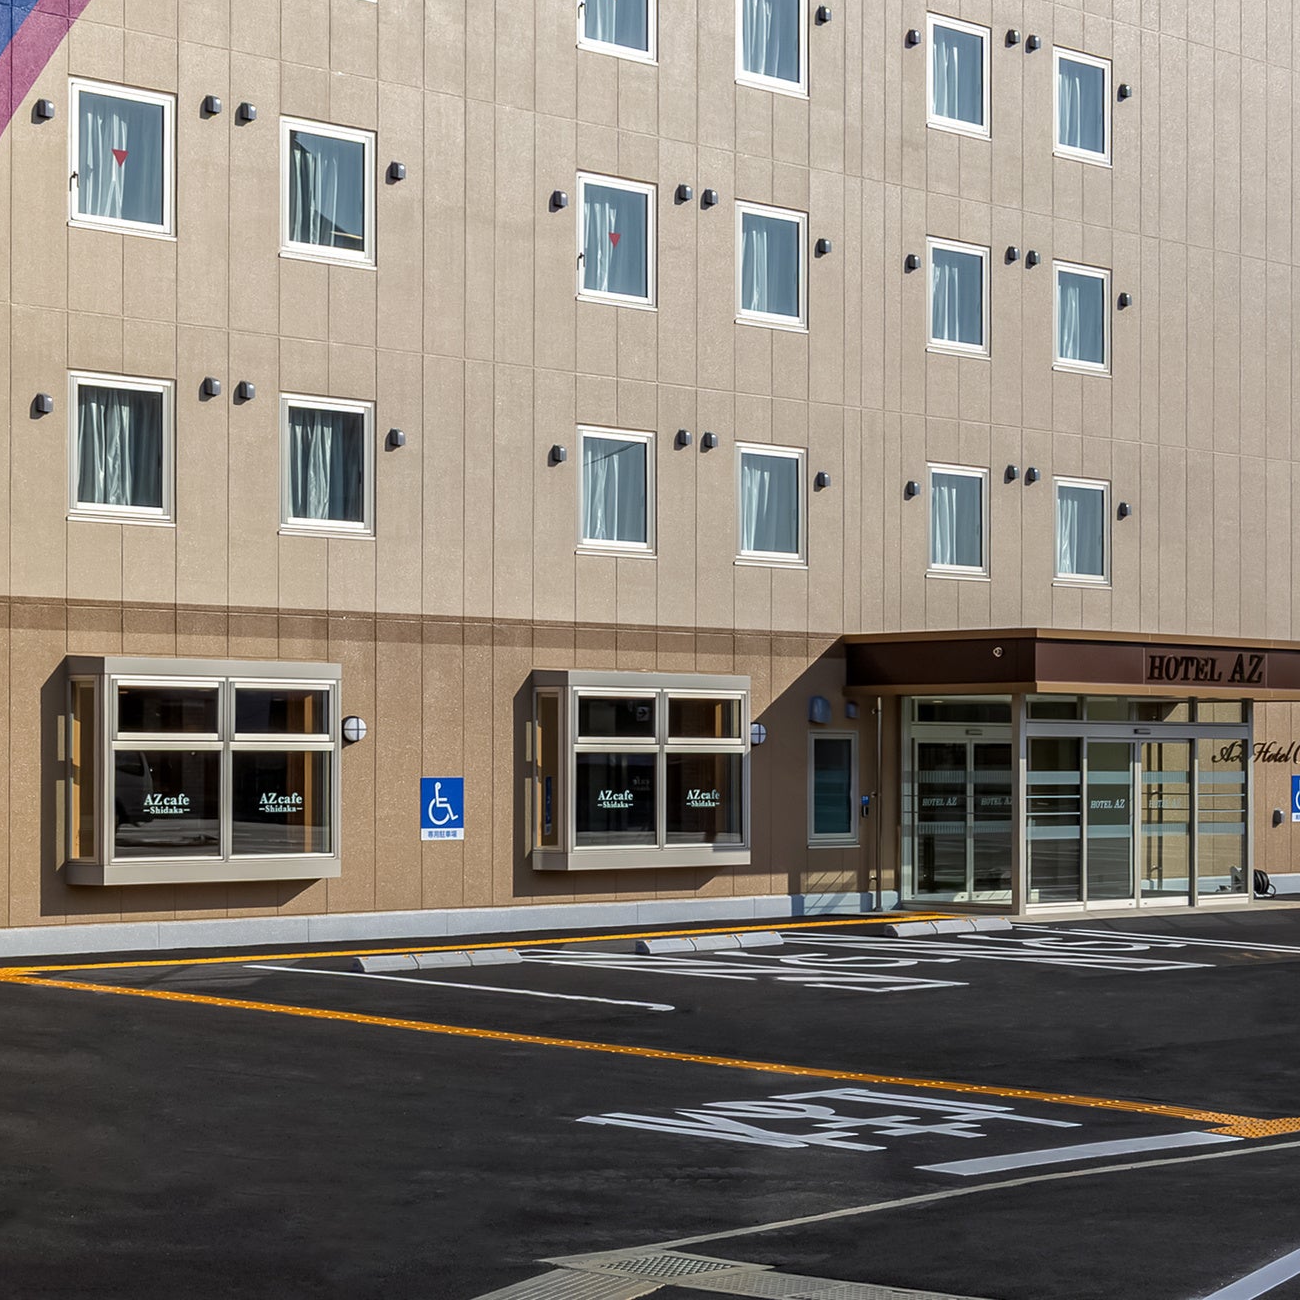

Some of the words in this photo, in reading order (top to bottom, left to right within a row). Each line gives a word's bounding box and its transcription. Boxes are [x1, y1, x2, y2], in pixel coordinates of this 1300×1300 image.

[1147, 655, 1223, 682] HOTEL
[1228, 653, 1264, 683] AZ
[1253, 740, 1292, 763] Hotel
[1090, 800, 1112, 809] HOTEL
[1114, 799, 1126, 809] AZ
